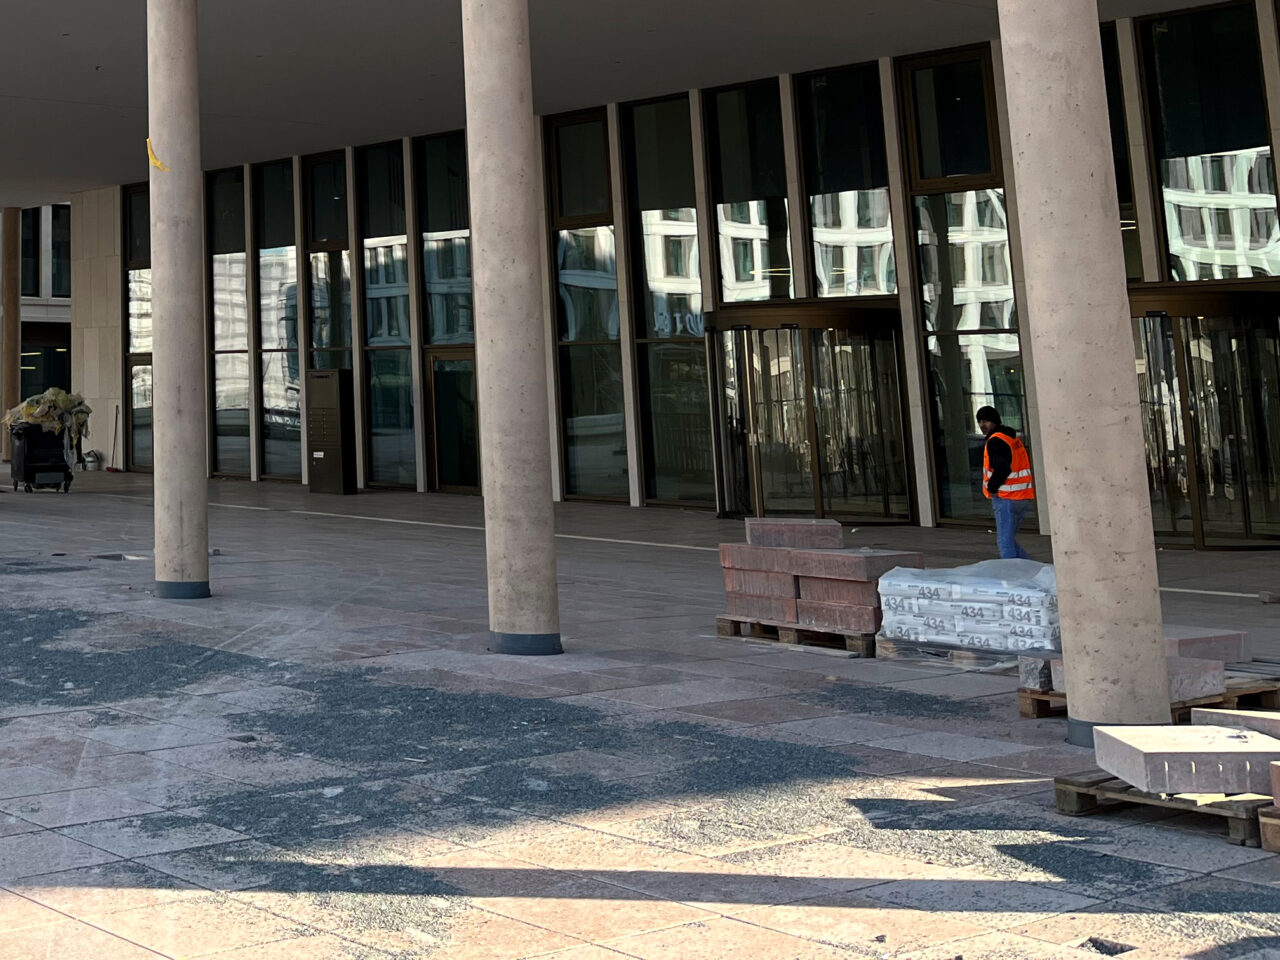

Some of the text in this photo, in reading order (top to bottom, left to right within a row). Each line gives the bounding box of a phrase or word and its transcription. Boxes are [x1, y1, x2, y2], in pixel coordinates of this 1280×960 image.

[918, 586, 940, 600] 434
[1008, 593, 1032, 607] 434
[884, 597, 905, 611] 434
[961, 606, 985, 619] 434
[1007, 607, 1032, 623] 434
[1010, 625, 1034, 640] 434
[967, 636, 991, 649] 434
